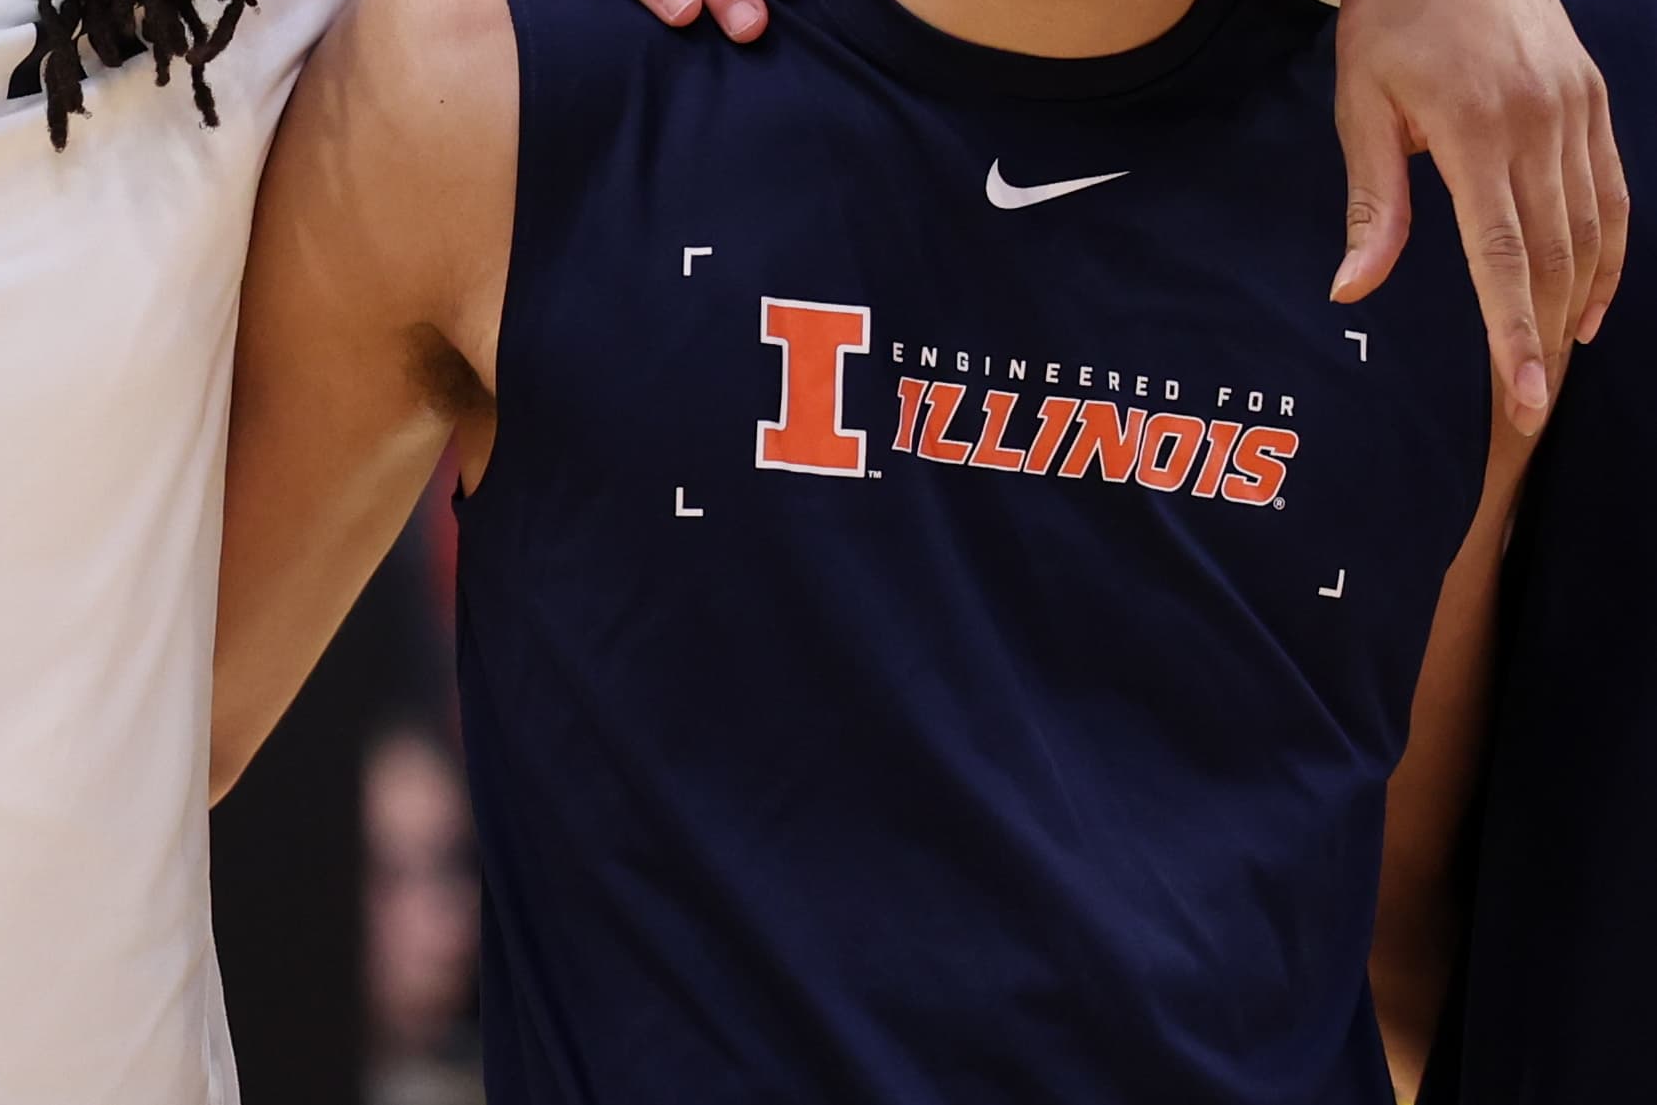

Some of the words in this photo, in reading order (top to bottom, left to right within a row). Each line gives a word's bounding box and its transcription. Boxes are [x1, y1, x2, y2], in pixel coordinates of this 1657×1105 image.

[755, 296, 870, 477] I
[892, 342, 1179, 400] ENGINEERED
[1217, 388, 1294, 416] FOR
[892, 377, 1299, 506] ILLINOIS
